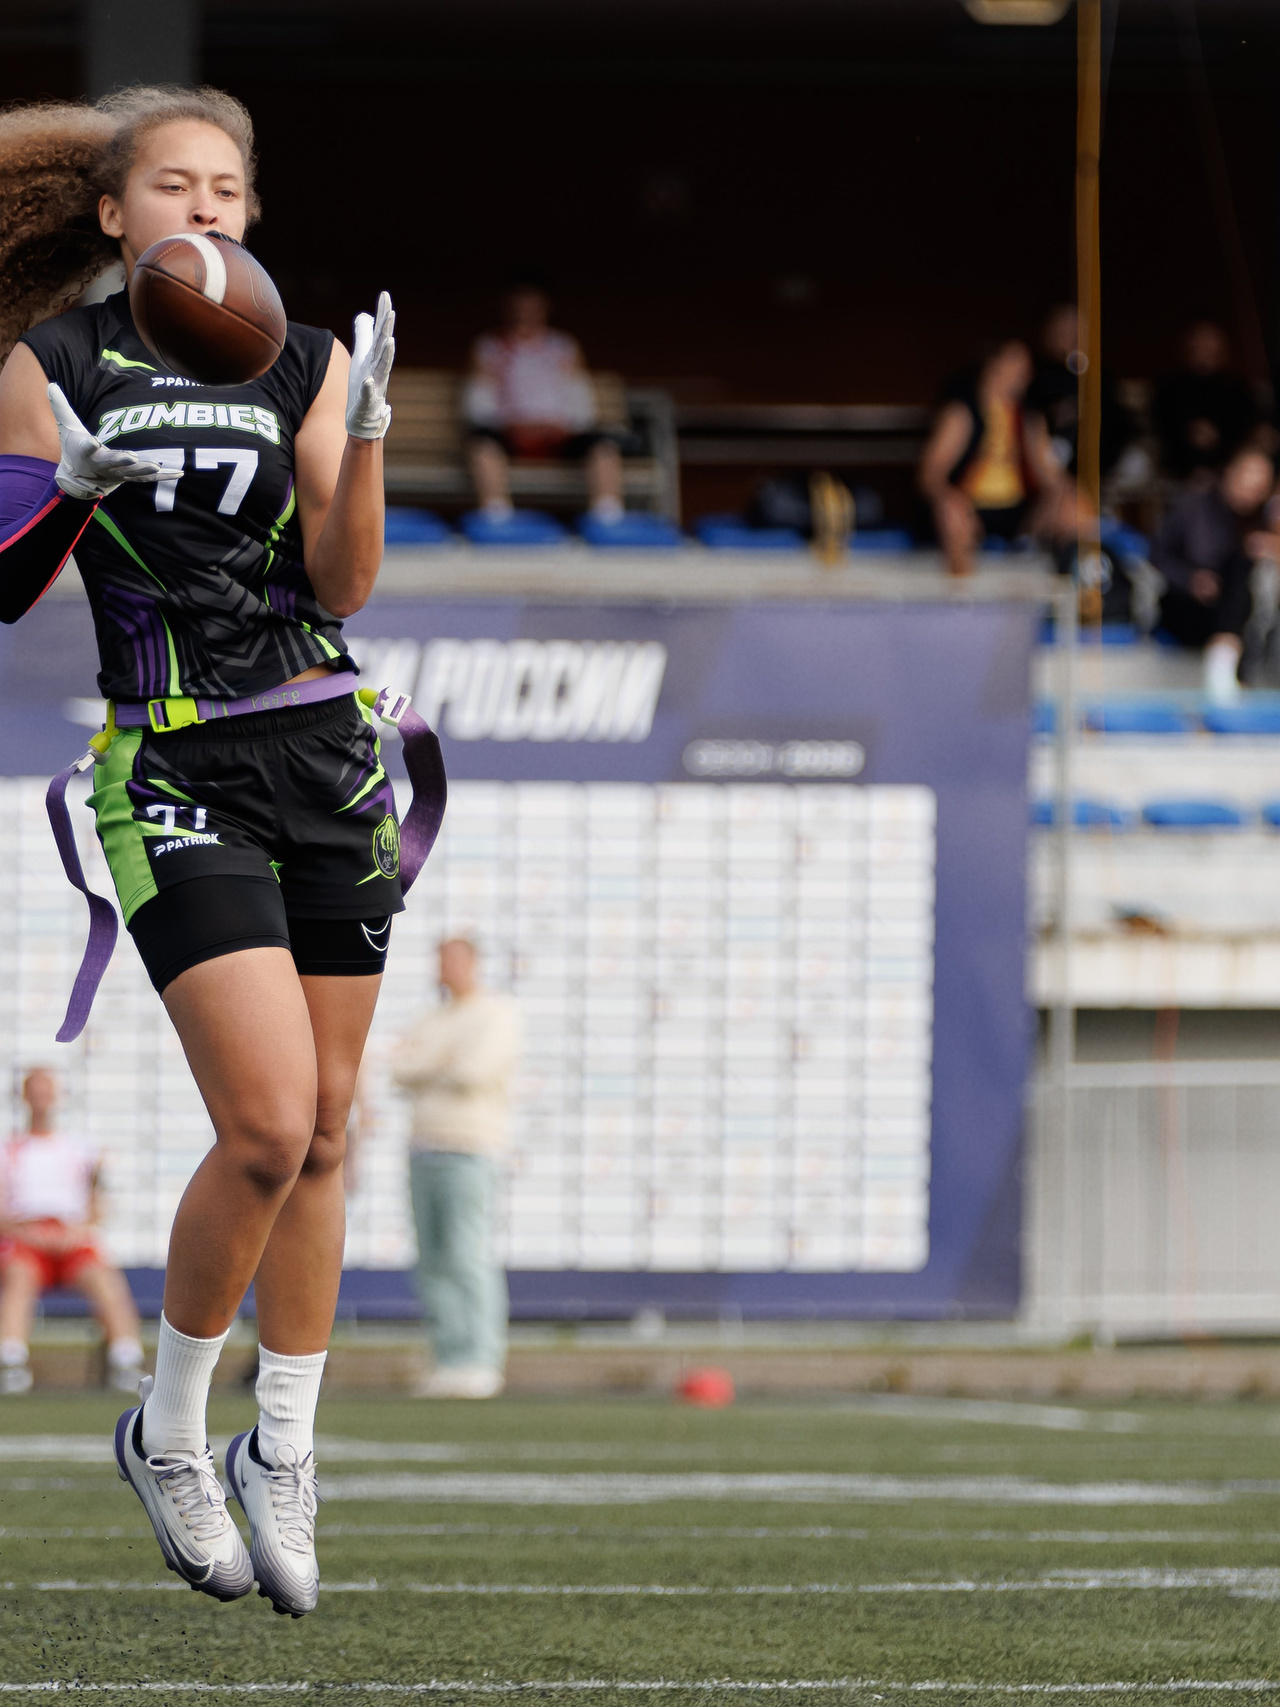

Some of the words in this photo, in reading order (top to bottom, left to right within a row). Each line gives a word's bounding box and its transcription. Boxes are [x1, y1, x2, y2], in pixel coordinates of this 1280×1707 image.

[96, 402, 281, 445] ZOMBIES
[132, 447, 259, 516] 77
[165, 832, 220, 852] PATRICK
